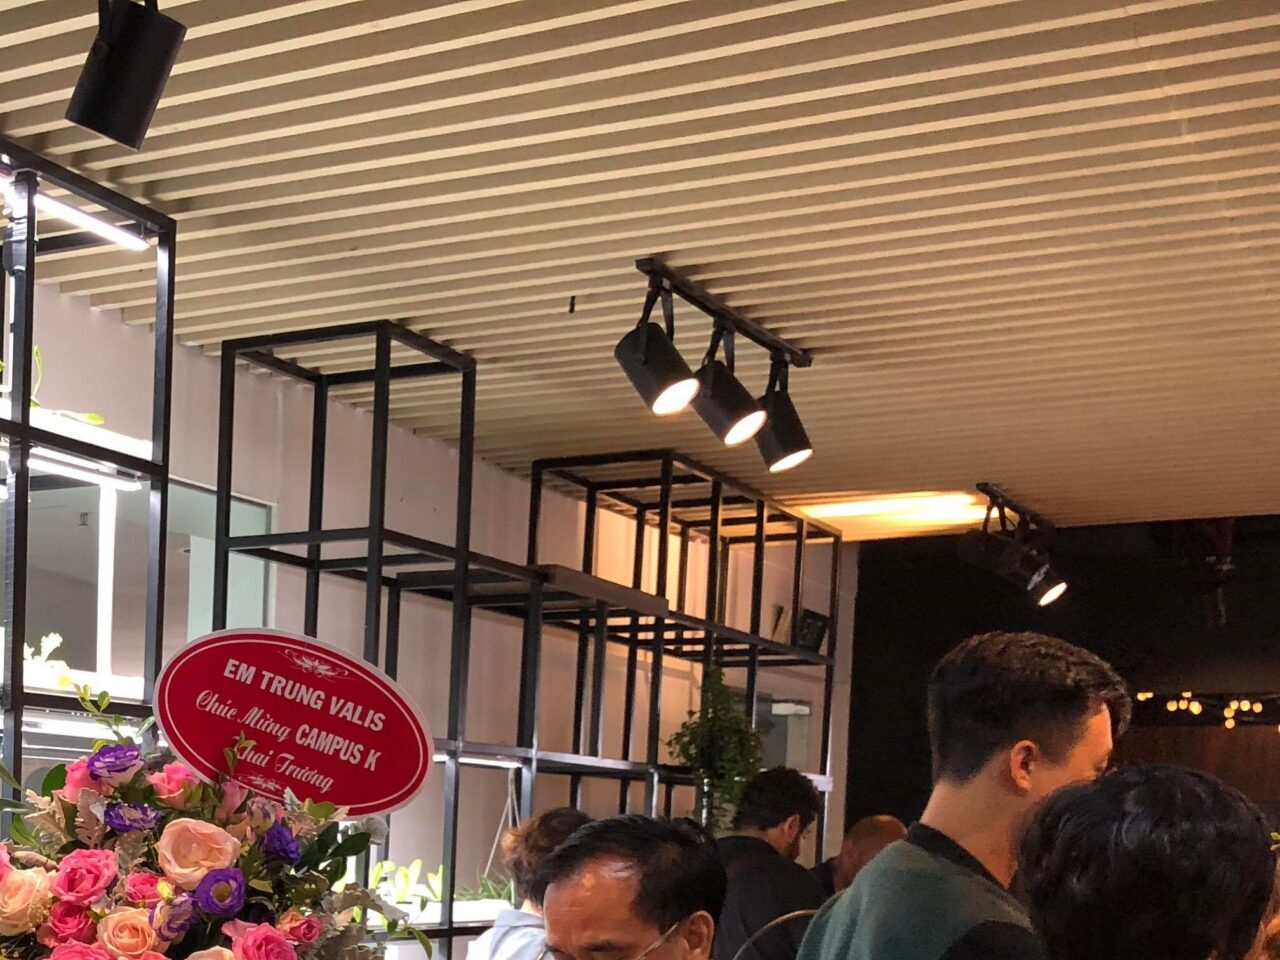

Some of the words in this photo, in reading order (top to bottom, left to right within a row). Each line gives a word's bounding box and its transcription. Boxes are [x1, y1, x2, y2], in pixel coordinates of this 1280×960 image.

[195, 689, 238, 720] Chúc
[237, 705, 292, 743] Mừng
[295, 724, 364, 765] CAMPUS
[361, 748, 382, 772] K
[223, 658, 256, 685] EM
[260, 670, 325, 711] TRUNG
[328, 695, 387, 732] VALIS
